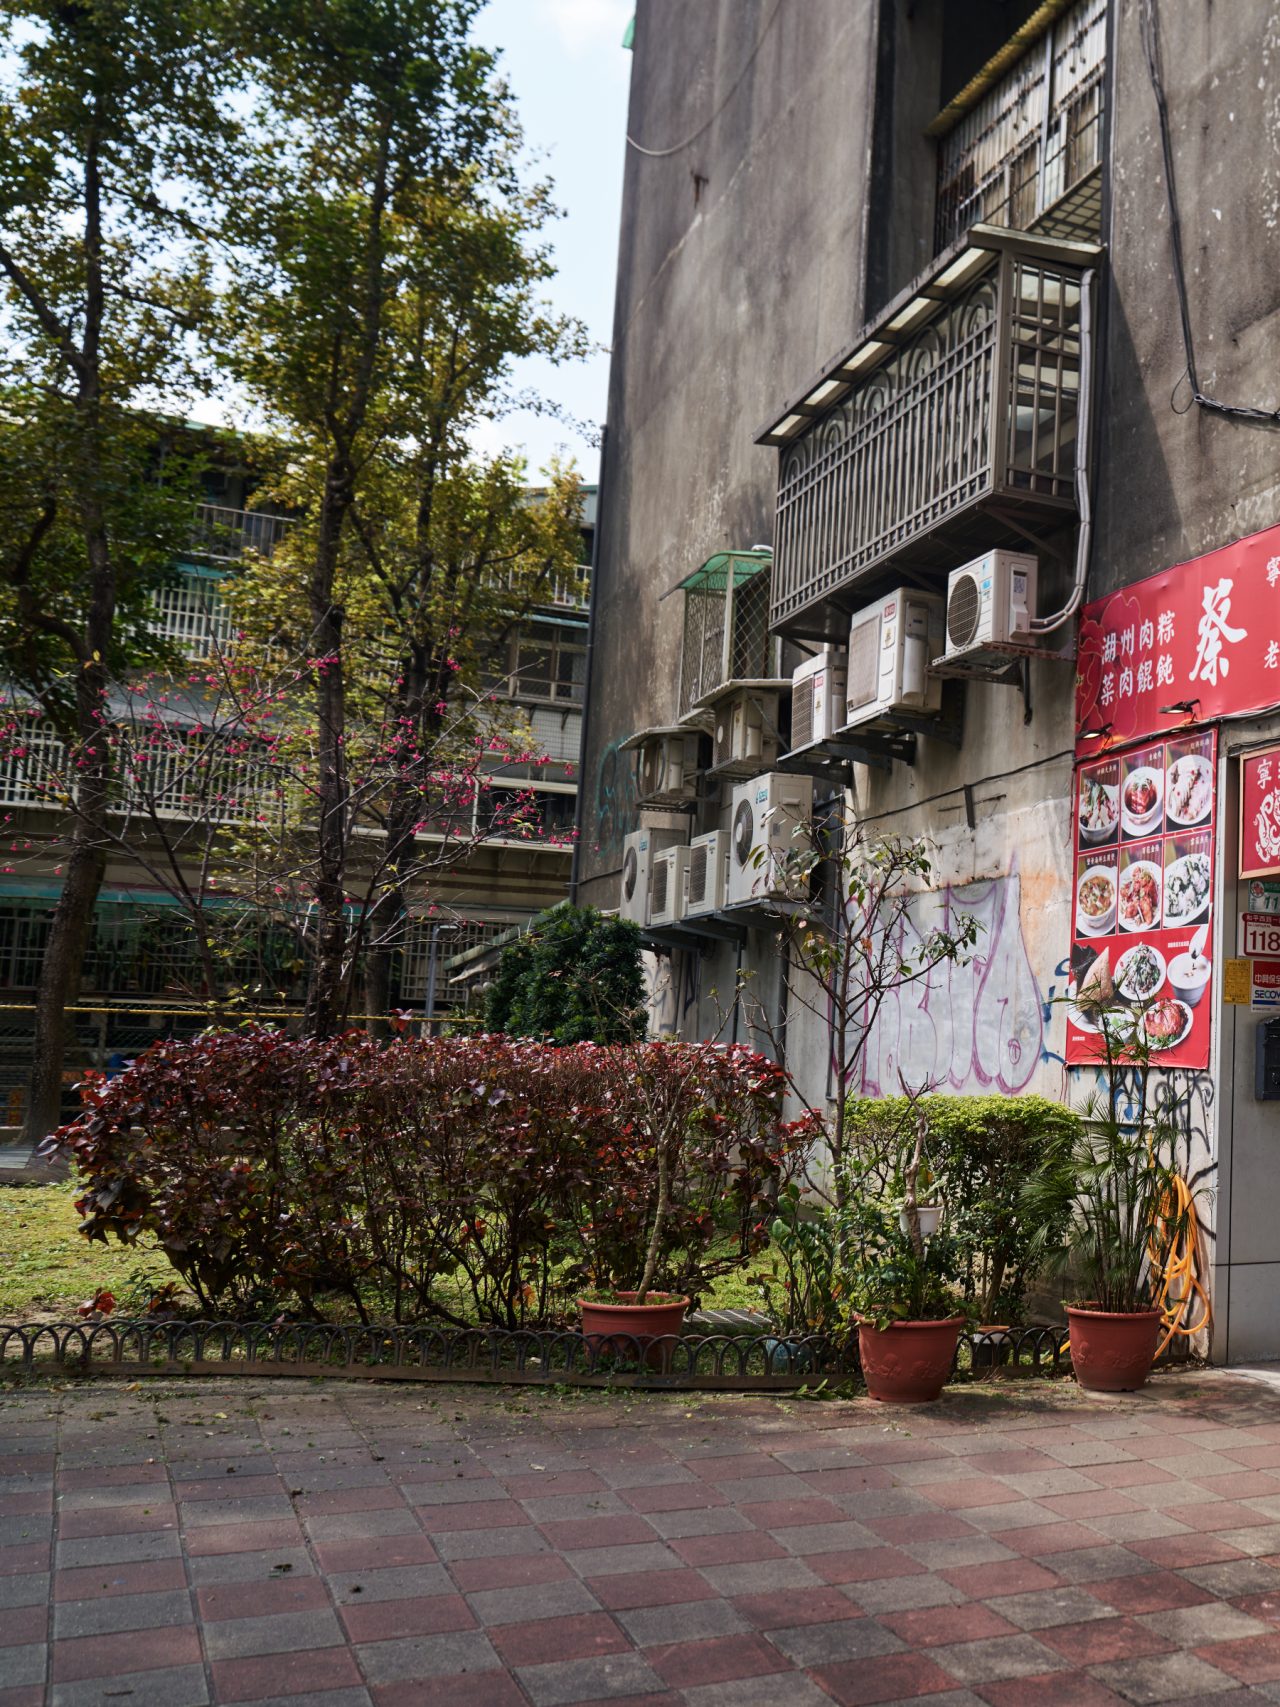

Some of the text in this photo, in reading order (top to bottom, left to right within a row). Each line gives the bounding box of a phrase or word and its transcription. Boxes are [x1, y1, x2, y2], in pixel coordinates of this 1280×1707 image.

[1101, 610, 1175, 665] 湖州肉粽
[1100, 653, 1175, 707] 菜肉餛飩
[1249, 930, 1280, 952] 118
